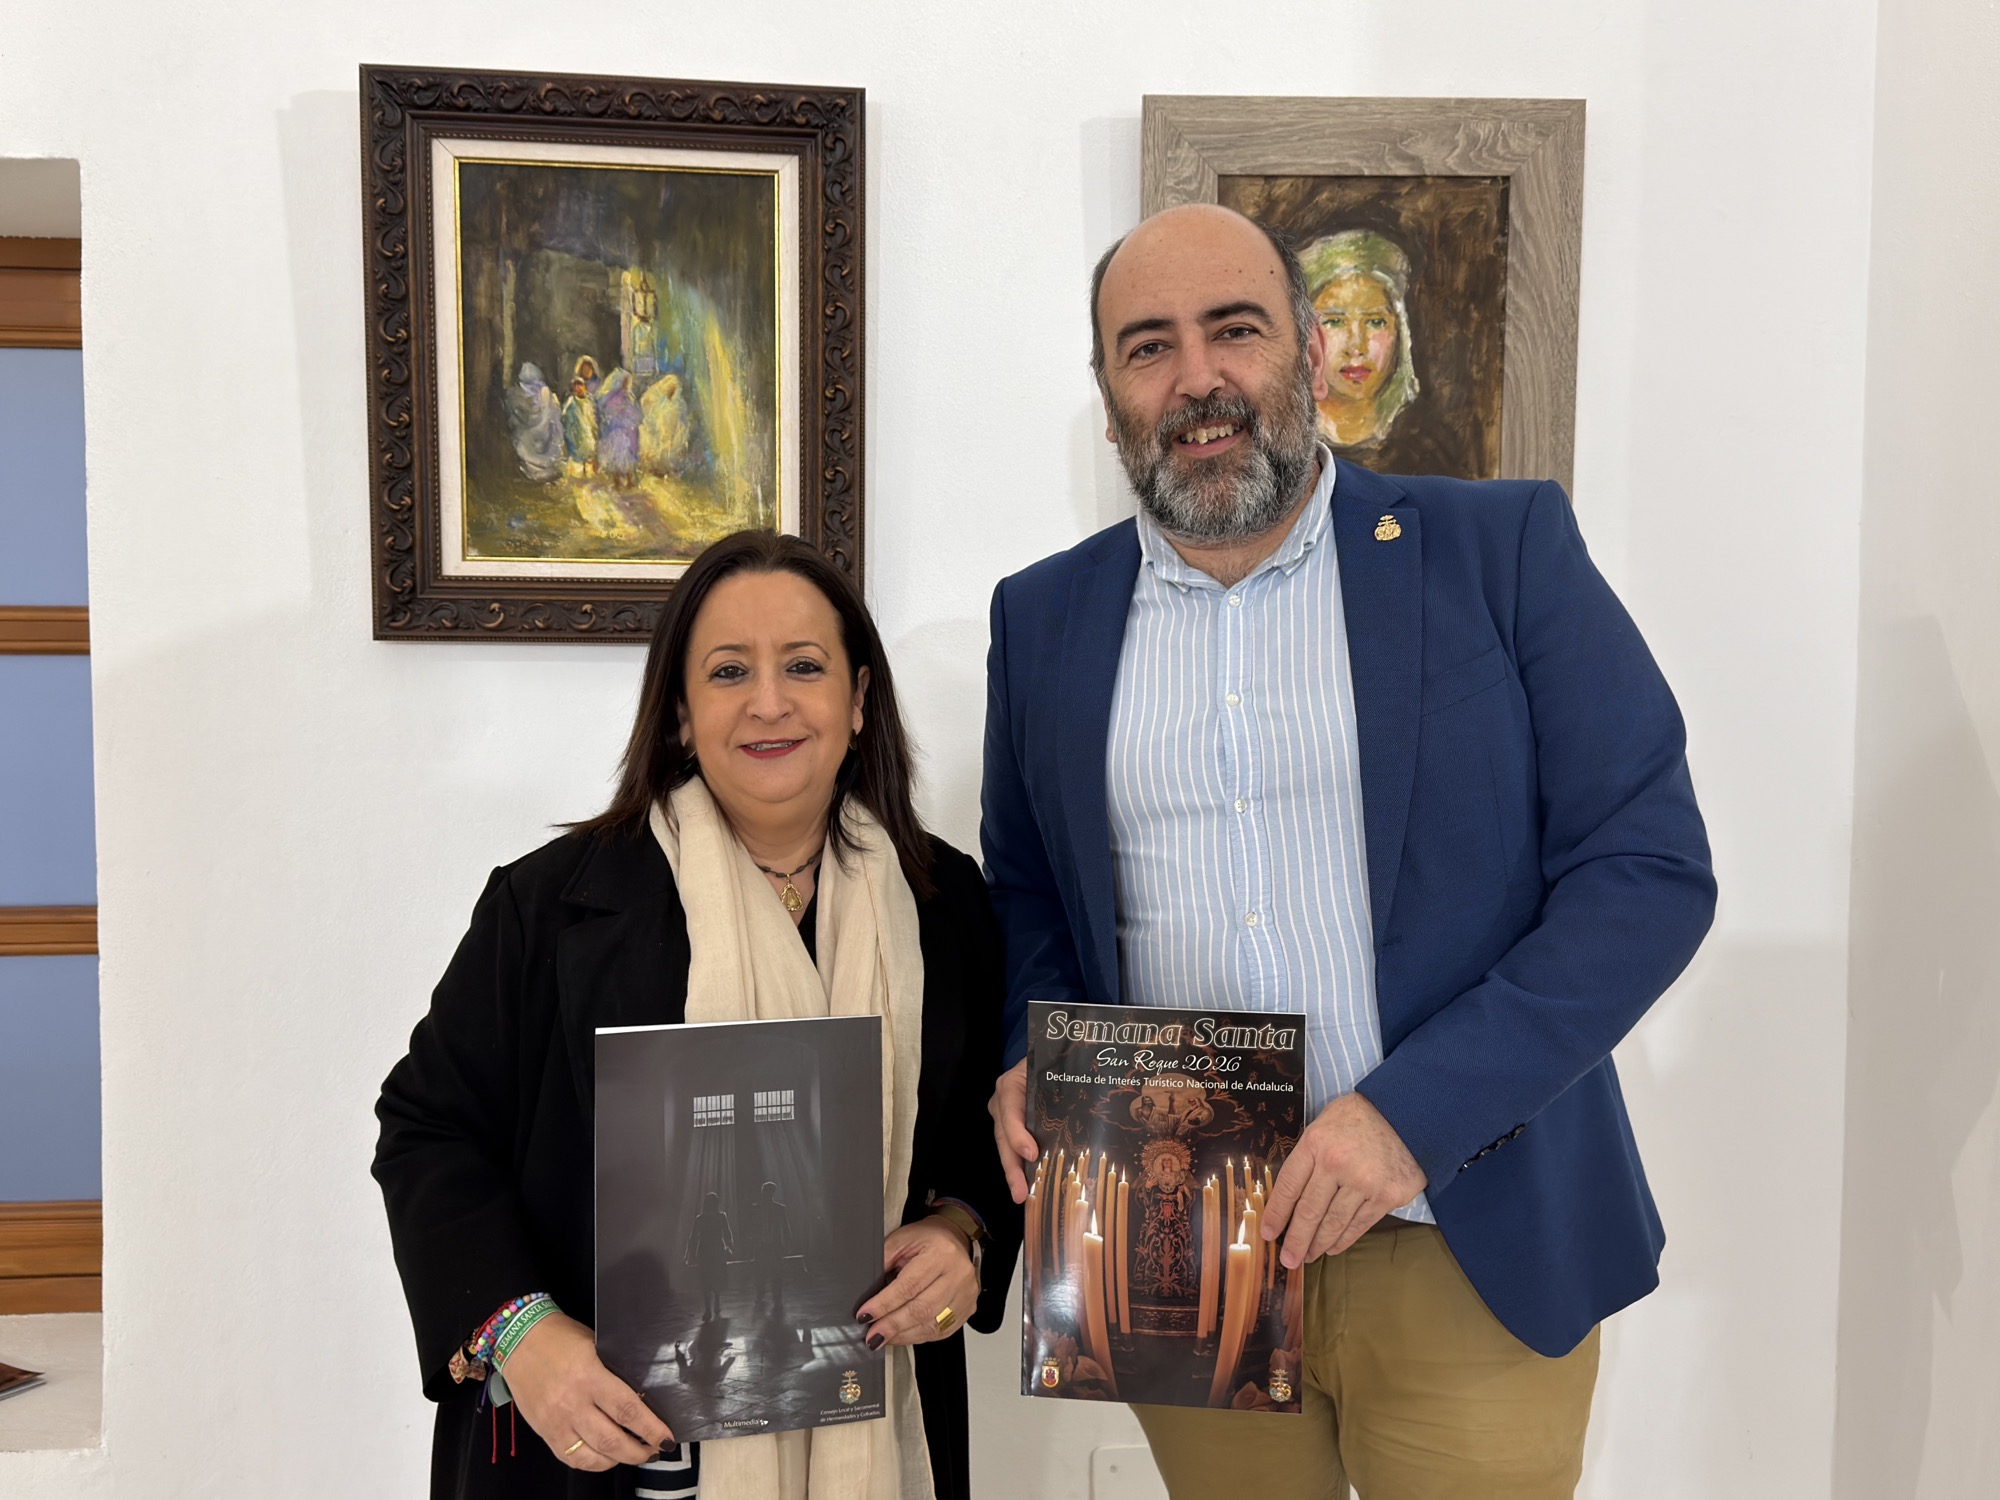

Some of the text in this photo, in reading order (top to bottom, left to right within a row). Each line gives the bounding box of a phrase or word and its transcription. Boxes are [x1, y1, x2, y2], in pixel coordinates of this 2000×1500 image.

[1046, 1010, 1297, 1051] Semana Santa
[1096, 1047, 1242, 1076] San Roque 2026
[1046, 1071, 1294, 1093] Declarada de Interés Turístico Nacional de Andalucía
[500, 1321, 523, 1350] SEMANA
[520, 1304, 544, 1324] SANTA
[723, 1418, 759, 1428] Multimedia
